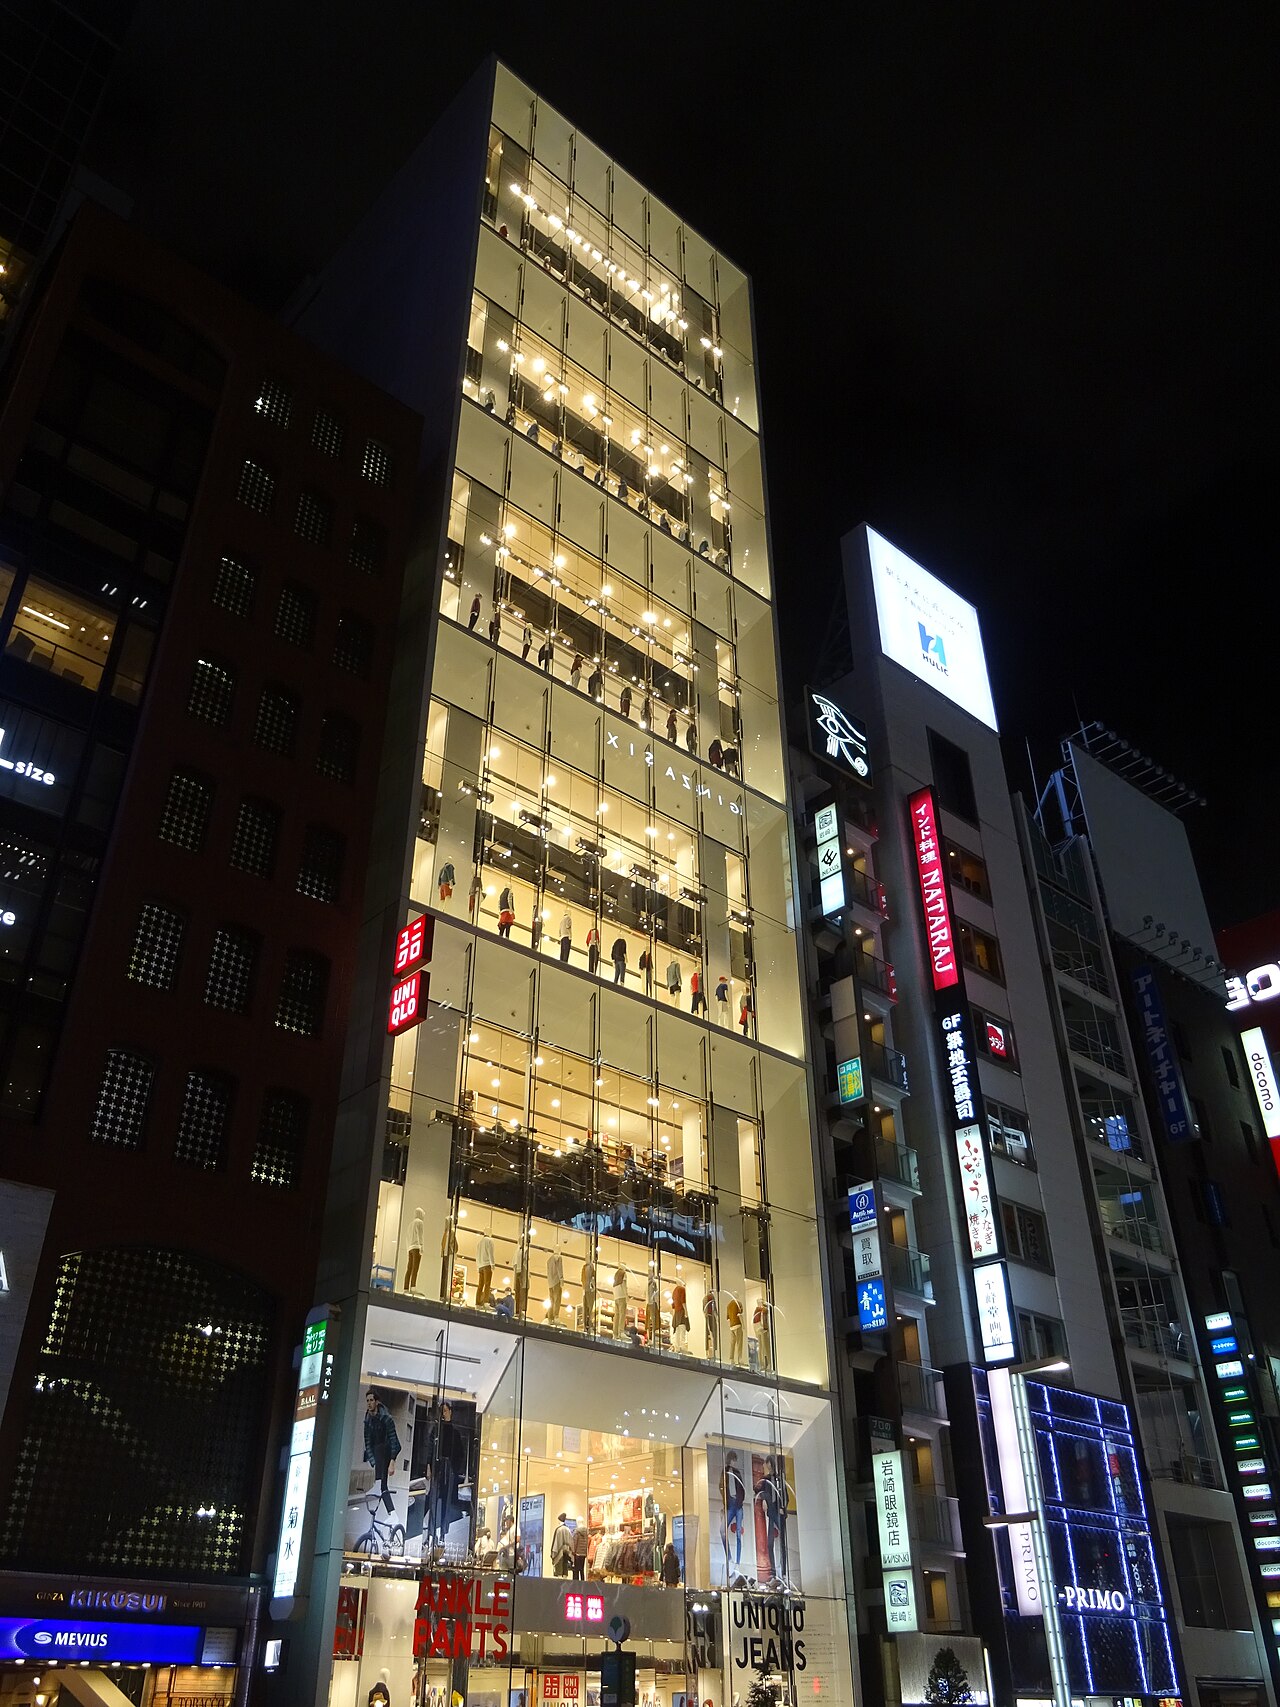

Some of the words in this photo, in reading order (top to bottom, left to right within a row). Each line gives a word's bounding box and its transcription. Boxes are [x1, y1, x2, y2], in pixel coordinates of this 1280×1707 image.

[922, 653, 949, 677] HULIC
[15, 761, 55, 786] size
[915, 803, 938, 864] インド料理
[923, 869, 953, 973] NATARAJ
[942, 1013, 962, 1030] 6F
[1251, 1052, 1274, 1111] docomo
[1169, 1120, 1186, 1134] 6F
[860, 1237, 873, 1266] 買取
[860, 1290, 885, 1318] 青山
[1239, 1460, 1263, 1469] docomo
[881, 1459, 900, 1546] 岩崎眼鏡店
[1245, 1486, 1269, 1495] docomo
[1250, 1511, 1274, 1521] docomo
[1019, 1523, 1039, 1601] -PRIMO
[414, 1575, 511, 1617] ANKLE
[1055, 1584, 1126, 1611] -PRIMO
[733, 1600, 806, 1636] UNIQLO
[54, 1632, 108, 1647] MEVIUS
[412, 1618, 509, 1662] PANTS
[735, 1636, 807, 1671] JEANS
